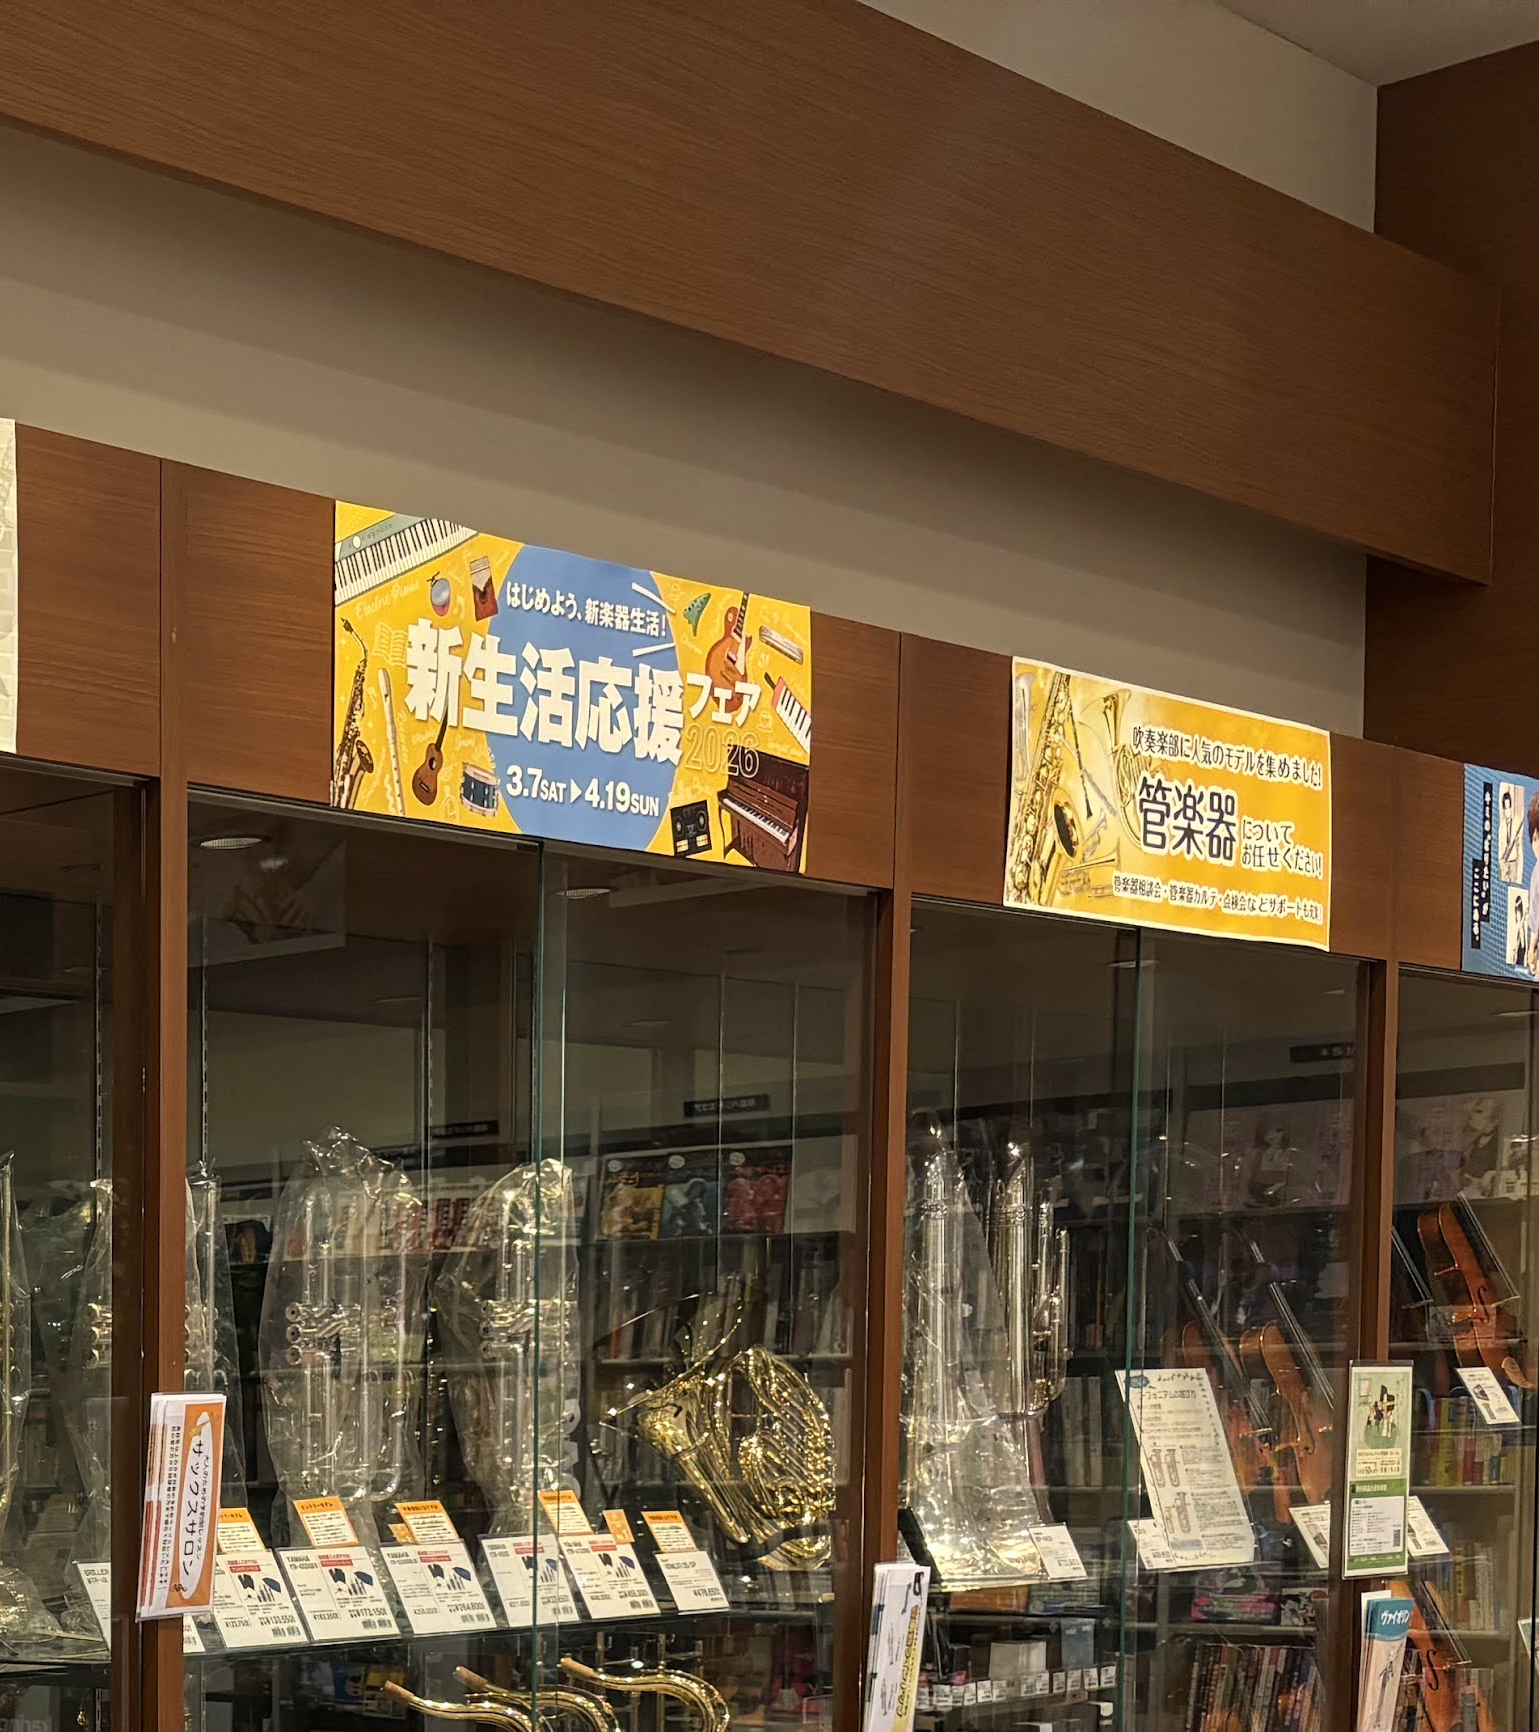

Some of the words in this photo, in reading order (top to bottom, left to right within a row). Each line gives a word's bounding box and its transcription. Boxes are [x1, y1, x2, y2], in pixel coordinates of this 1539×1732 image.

[506, 581, 667, 637] はじめよう、新楽器生活!
[406, 619, 685, 765] 新生活応援
[686, 672, 761, 726] フェア
[686, 725, 760, 778] 2026
[1133, 727, 1321, 787] 吹奏楽部に人気のモデルを集めました!
[1139, 776, 1236, 861] 管楽器
[1243, 819, 1292, 845] について
[1242, 845, 1321, 875] お任せください!
[183, 1440, 204, 1577] サックスサロン
[1381, 1608, 1410, 1626] ヴァイオリン
